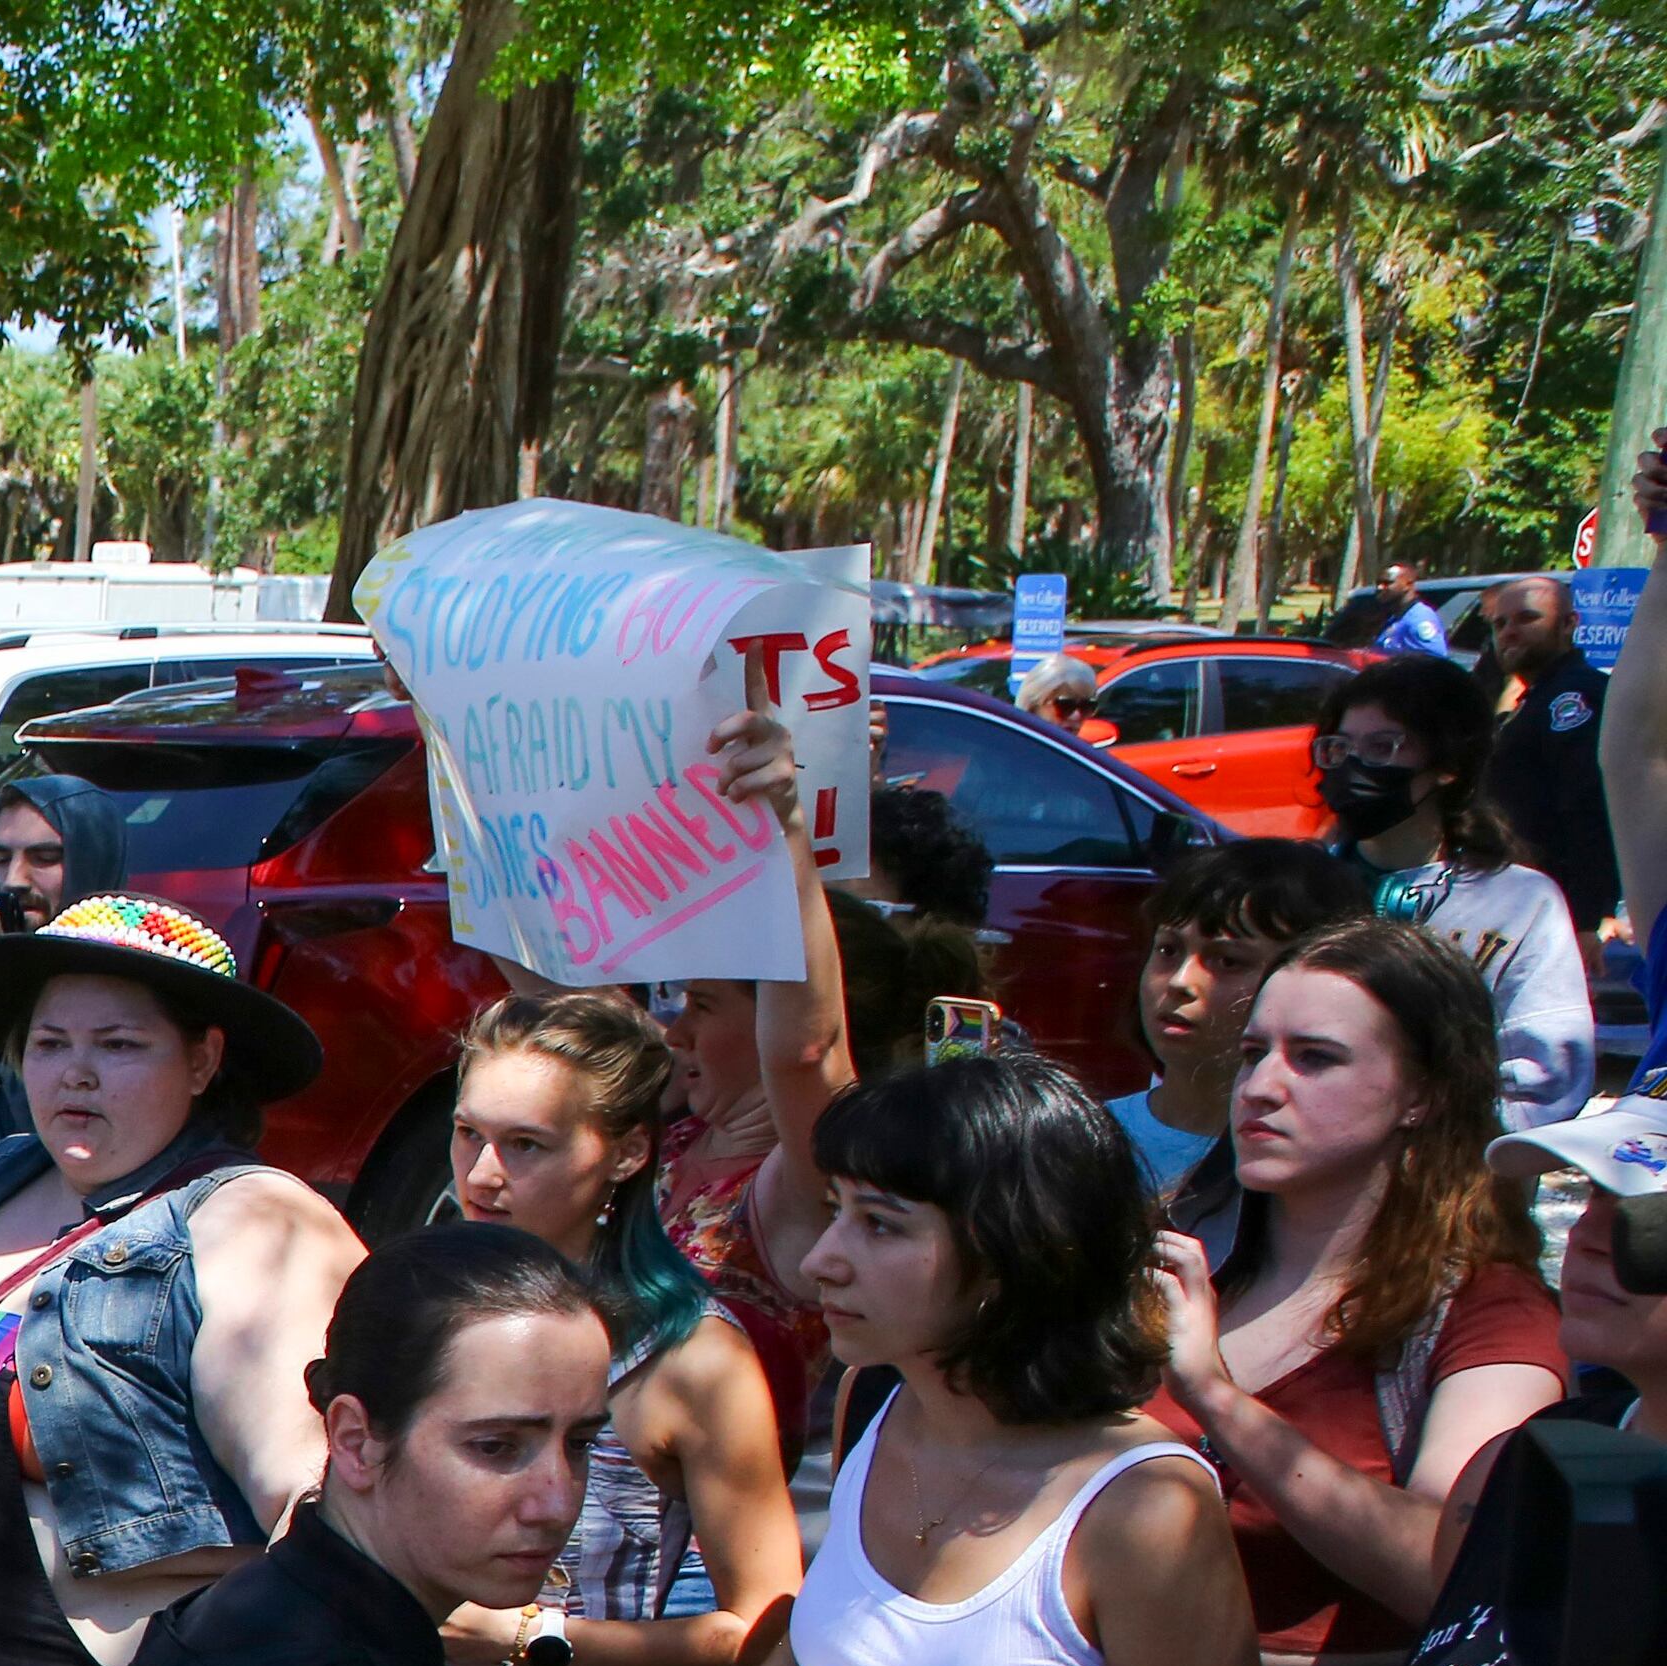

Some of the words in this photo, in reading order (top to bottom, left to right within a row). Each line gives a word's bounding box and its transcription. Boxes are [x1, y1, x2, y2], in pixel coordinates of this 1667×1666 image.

[387, 566, 634, 682] STUDYING
[616, 578, 782, 667] BUT
[464, 693, 590, 795] AFRAID
[601, 696, 678, 790] MY
[538, 763, 772, 966] BANNED
